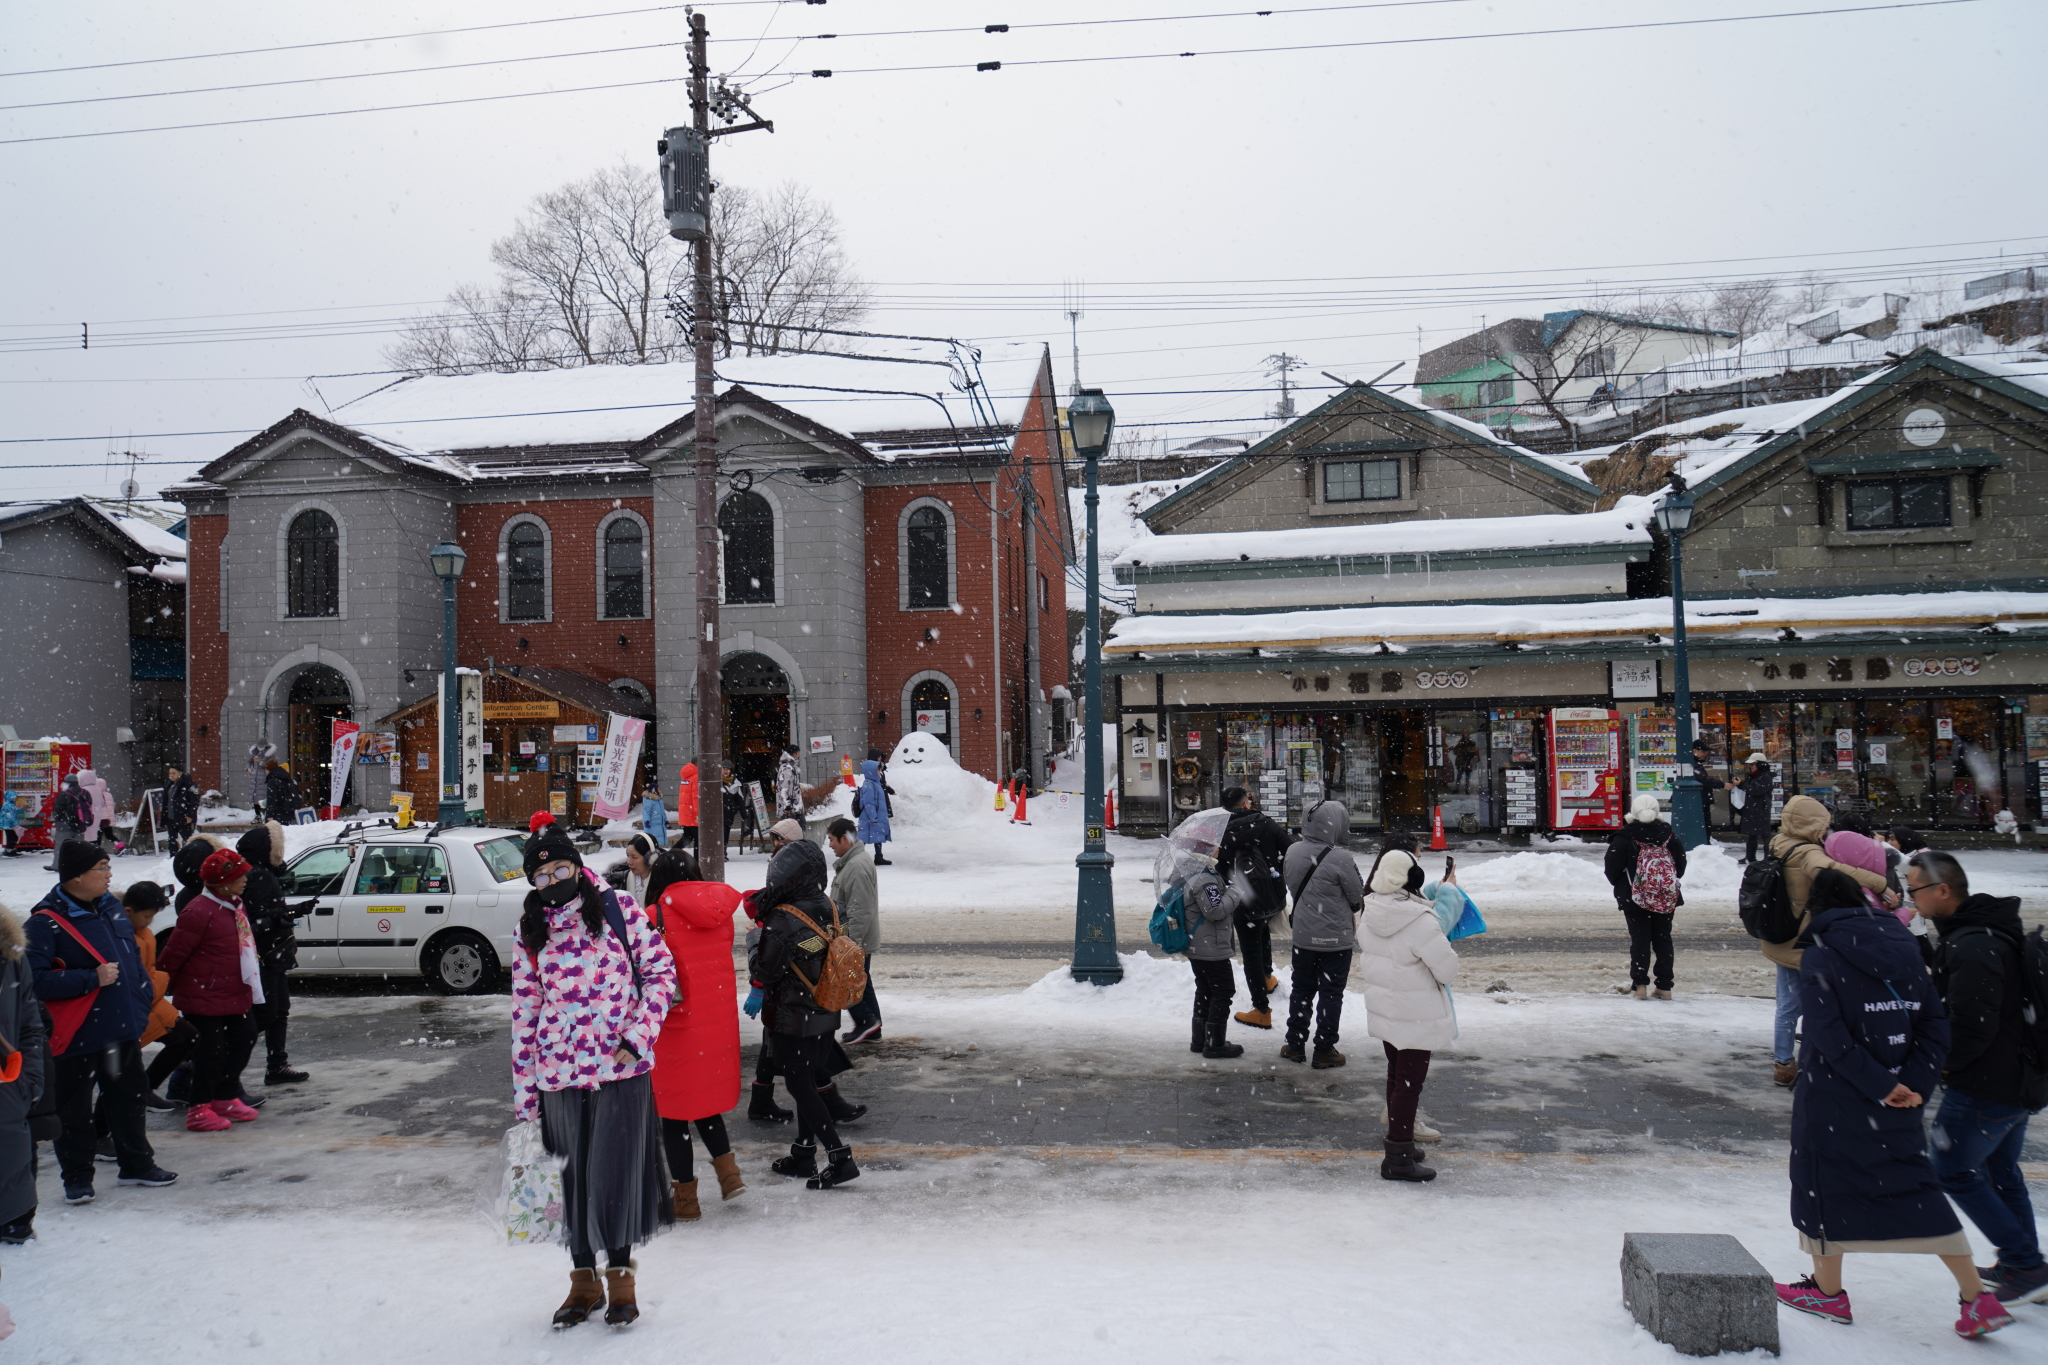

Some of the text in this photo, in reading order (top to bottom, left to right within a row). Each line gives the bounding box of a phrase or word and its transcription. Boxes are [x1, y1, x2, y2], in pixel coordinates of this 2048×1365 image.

[525, 703, 549, 711] Center
[466, 686, 478, 799] 大正硝子館
[604, 734, 628, 802] 観光案内所
[1088, 828, 1099, 838] 31
[1887, 1033, 1906, 1046] THE
